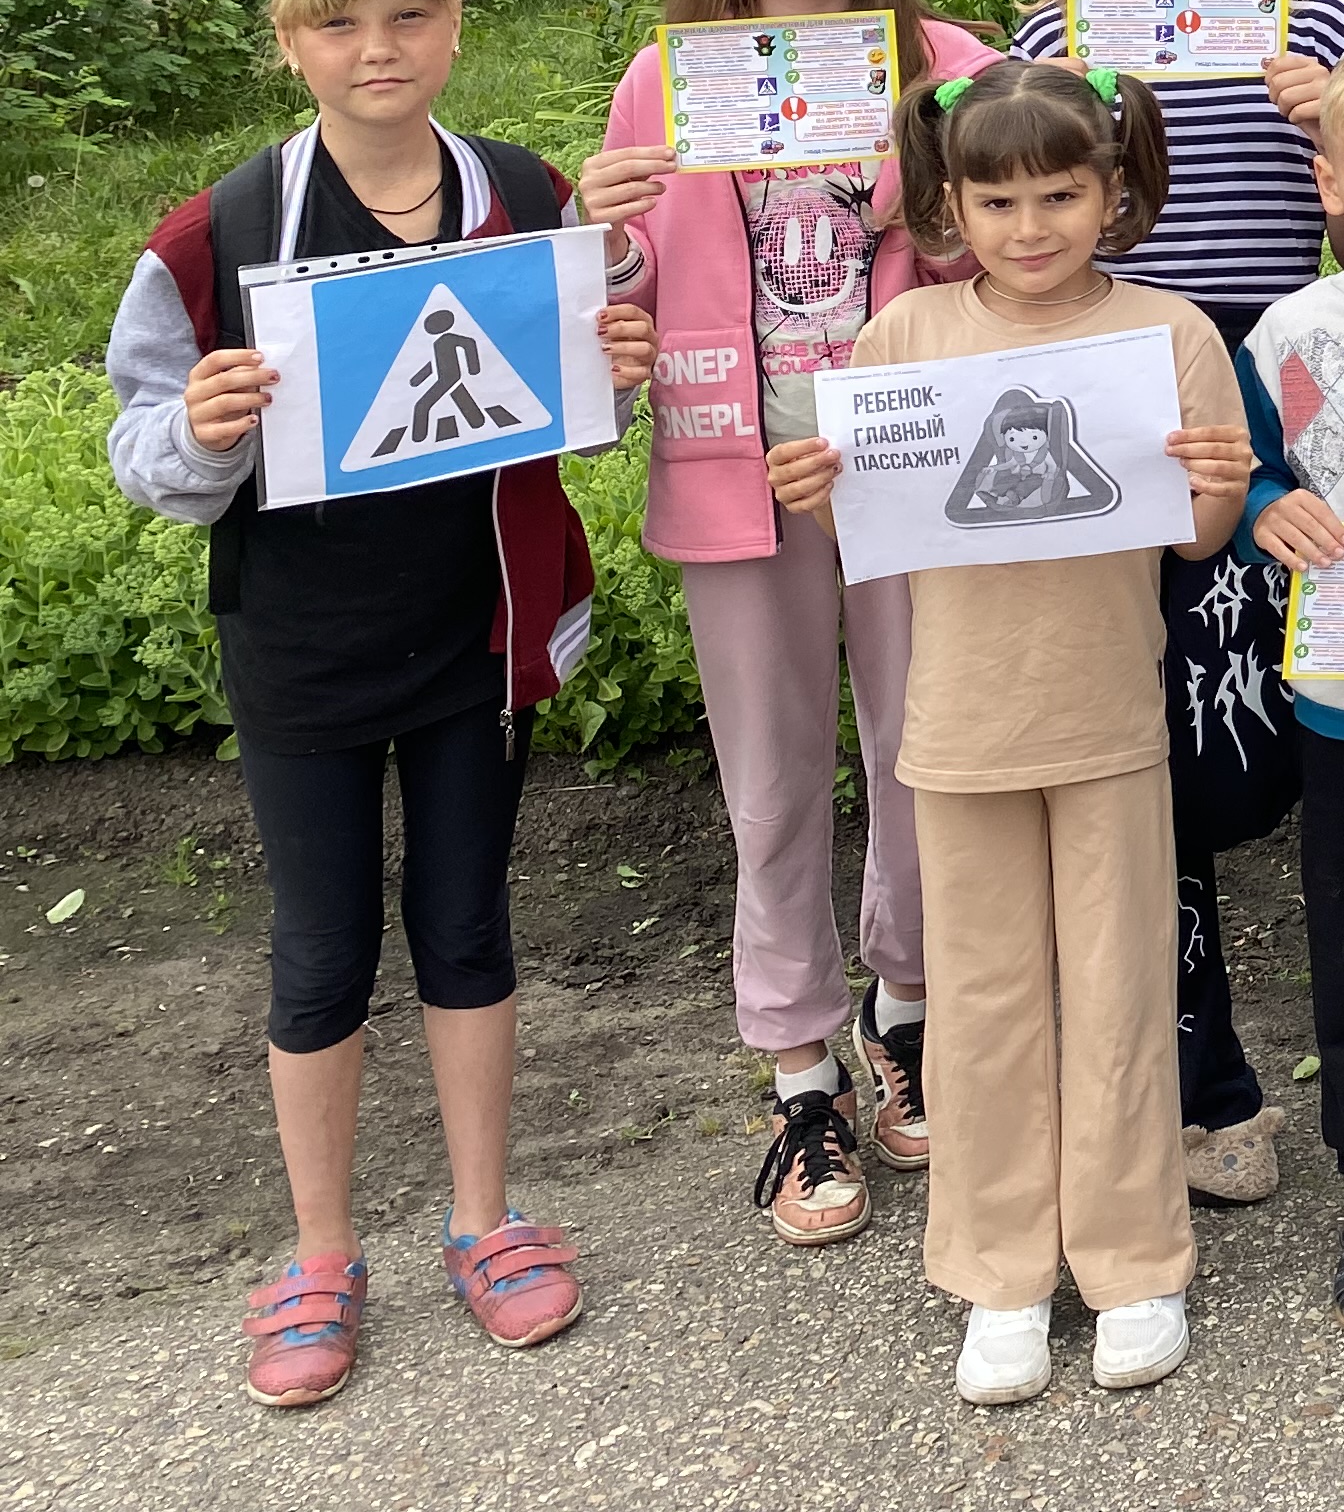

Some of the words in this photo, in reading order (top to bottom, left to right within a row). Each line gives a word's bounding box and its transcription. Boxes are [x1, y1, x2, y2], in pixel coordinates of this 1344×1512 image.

[853, 385, 942, 416] РЕБЕНОК-
[853, 413, 946, 447] ГЛАВНЫЙ
[854, 445, 961, 472] ПАССАЖИР!
